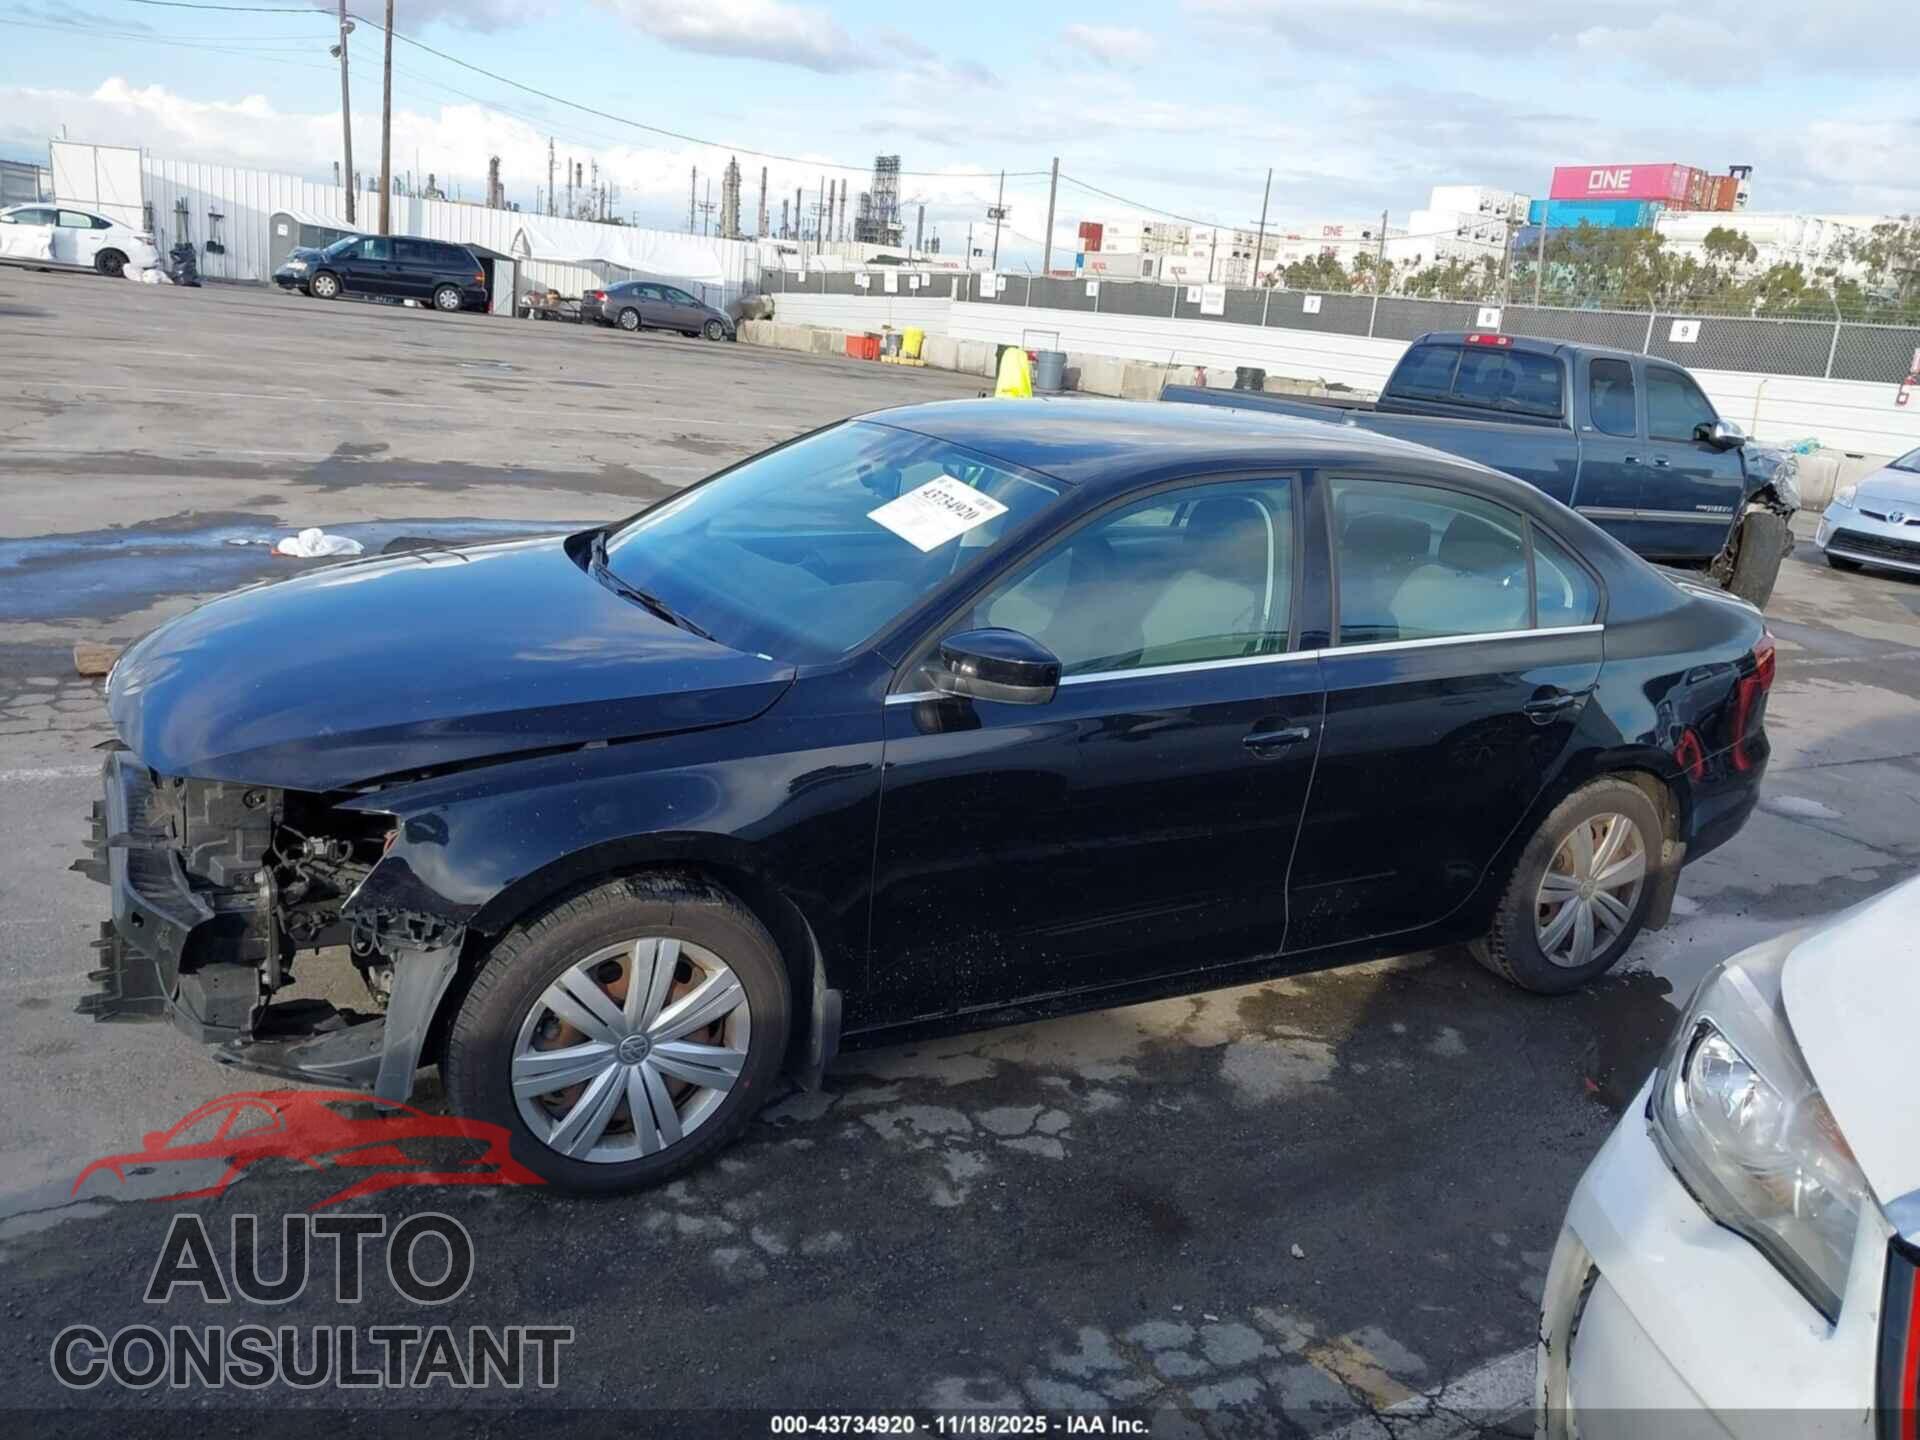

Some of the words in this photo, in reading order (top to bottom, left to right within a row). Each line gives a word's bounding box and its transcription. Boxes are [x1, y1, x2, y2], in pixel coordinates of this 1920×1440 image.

[1588, 169, 1632, 189] ONE
[1322, 225, 1344, 237] ONE
[1681, 325, 1689, 337] 9
